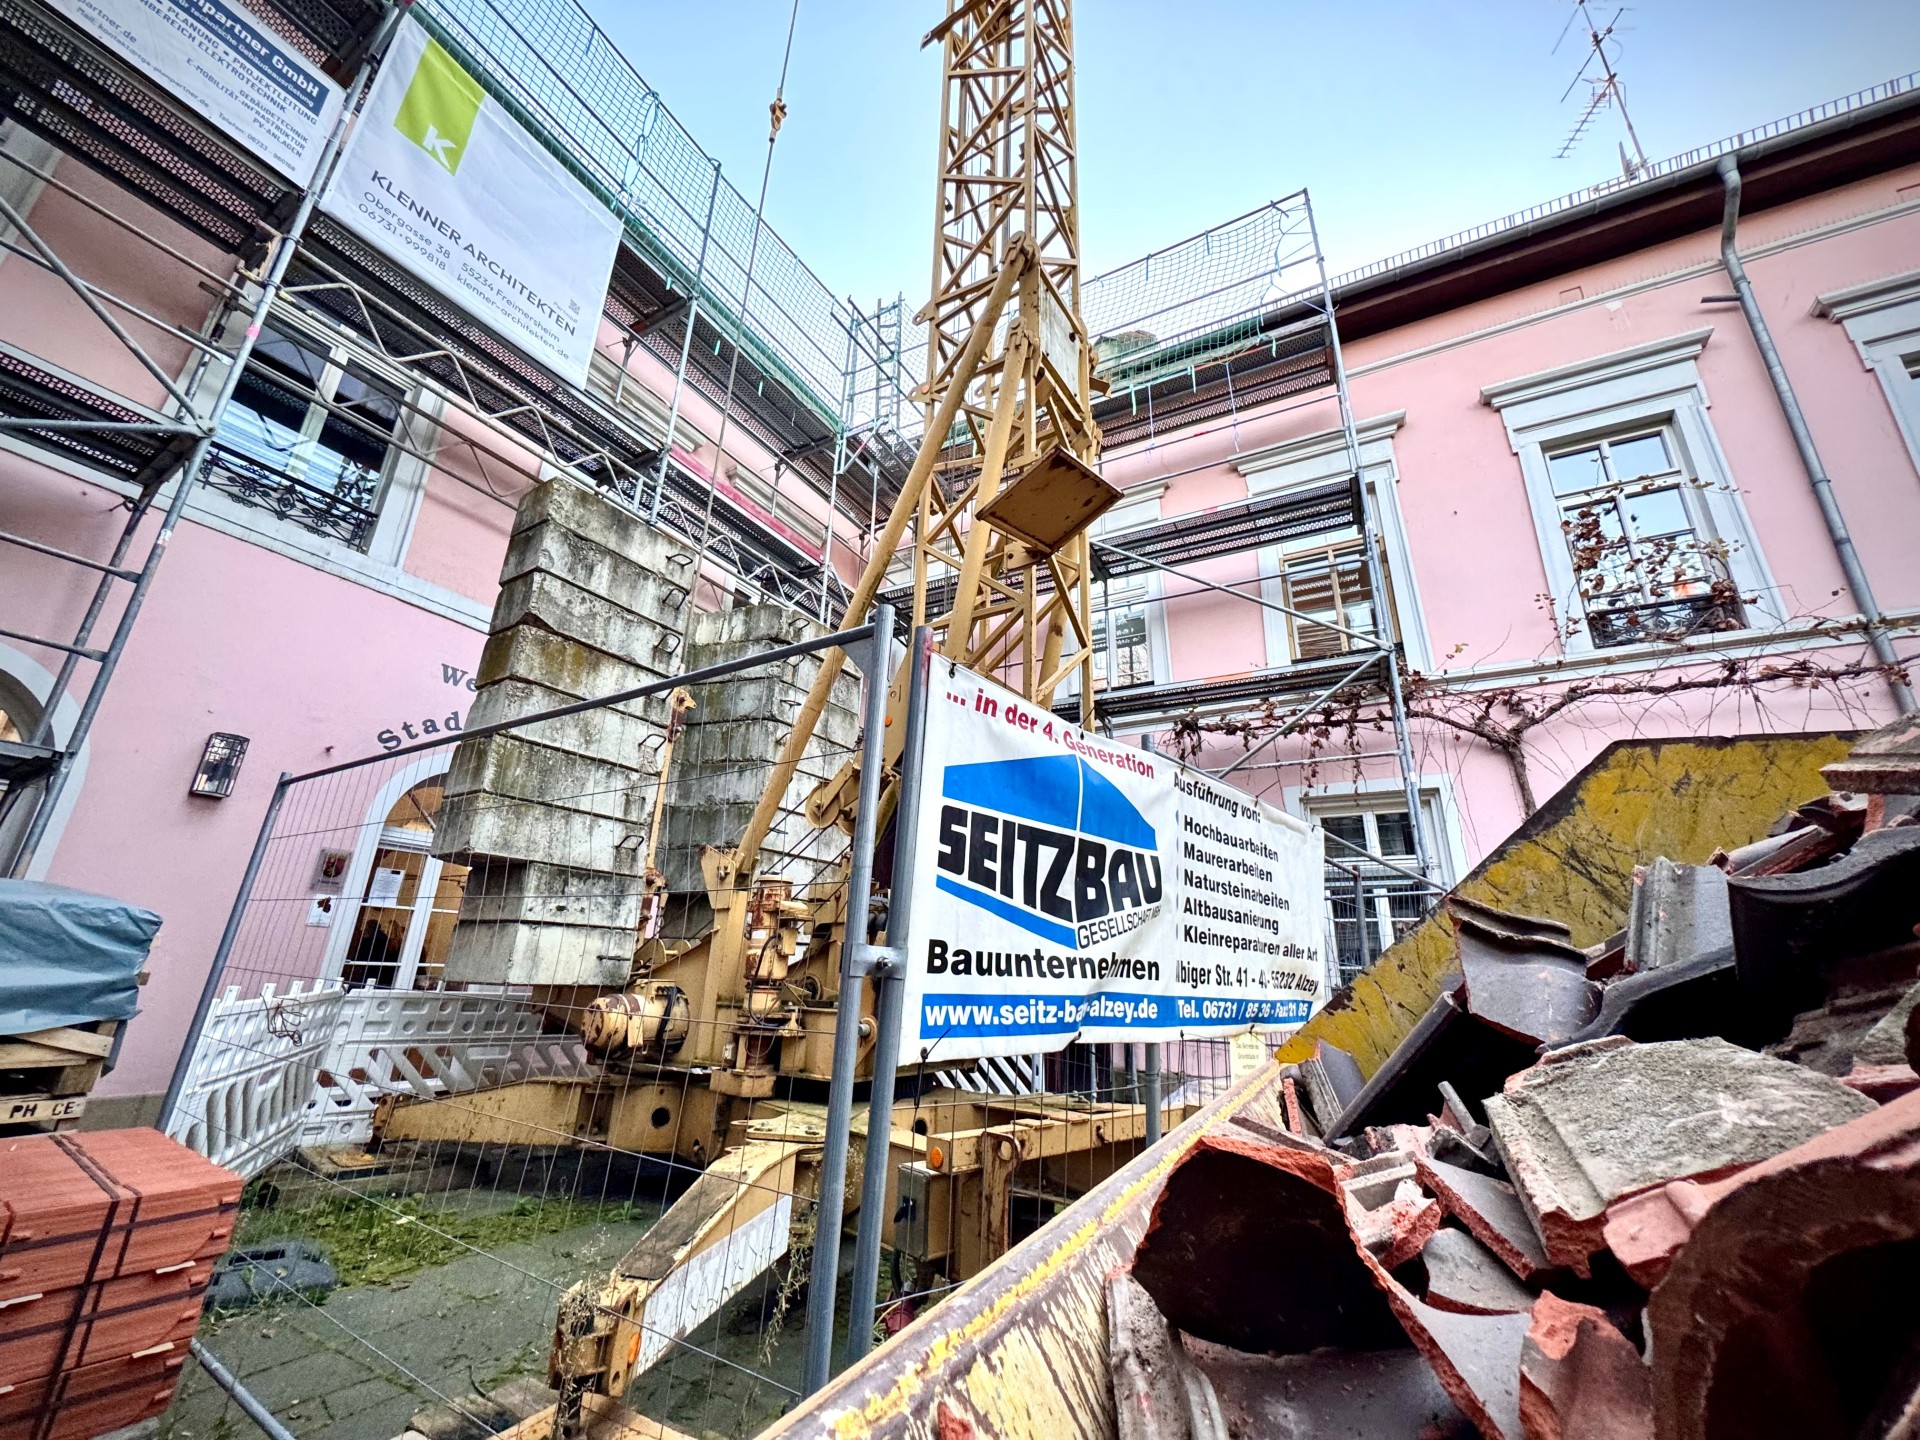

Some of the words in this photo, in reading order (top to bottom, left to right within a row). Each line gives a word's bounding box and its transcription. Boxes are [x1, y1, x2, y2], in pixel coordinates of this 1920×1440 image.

[167, 6, 220, 50] PLANUNG
[232, 57, 318, 125] PROJEKTLEITUNG
[190, 6, 238, 46] technische
[237, 44, 315, 108] Gebäudeausrüstung
[197, 41, 288, 113] ELEKTROTECHNIK
[271, 54, 320, 97] GmbH
[186, 57, 306, 151] E-MOBILITÄT-INFRASTRUKTUR
[218, 112, 246, 136] Telefon:
[239, 89, 309, 144] GEBÄUDETECHNIK
[252, 117, 303, 158] PV-ANLAGEN
[364, 191, 432, 246] Obergasse
[435, 244, 451, 259] 38
[461, 262, 494, 292] 55234
[495, 288, 560, 343] Freimersheim
[371, 169, 462, 246] KLENNER
[463, 243, 576, 337] ARCHITEKTEN
[456, 273, 569, 360] klenner-architekten.de
[975, 688, 998, 717] in
[1004, 703, 1039, 734] der
[1042, 721, 1059, 744] 4.
[1062, 730, 1155, 779] Generation
[1173, 771, 1239, 818] Ausführung
[1241, 804, 1261, 824] von:
[1184, 814, 1279, 863] Hochbauarbeiten
[1184, 841, 1273, 883] Maurerarbeiten
[1184, 868, 1290, 911] Natursteinarbeiten
[1077, 907, 1152, 950] GESELLSCHAFT
[1183, 896, 1279, 935] Altbausanierung
[926, 938, 1160, 981] Bauunternehmen
[1282, 942, 1305, 960] aller
[1306, 946, 1318, 962] Art
[1215, 963, 1233, 987] Str.
[1236, 966, 1248, 988] 41
[1294, 973, 1319, 997] Alzey
[1177, 999, 1200, 1018] Tel.
[1203, 1000, 1238, 1019] 06731
[1245, 1002, 1259, 1018] 85
[1258, 1002, 1271, 1018] 36
[1298, 1003, 1309, 1017] 85
[8, 1103, 38, 1119] PH
